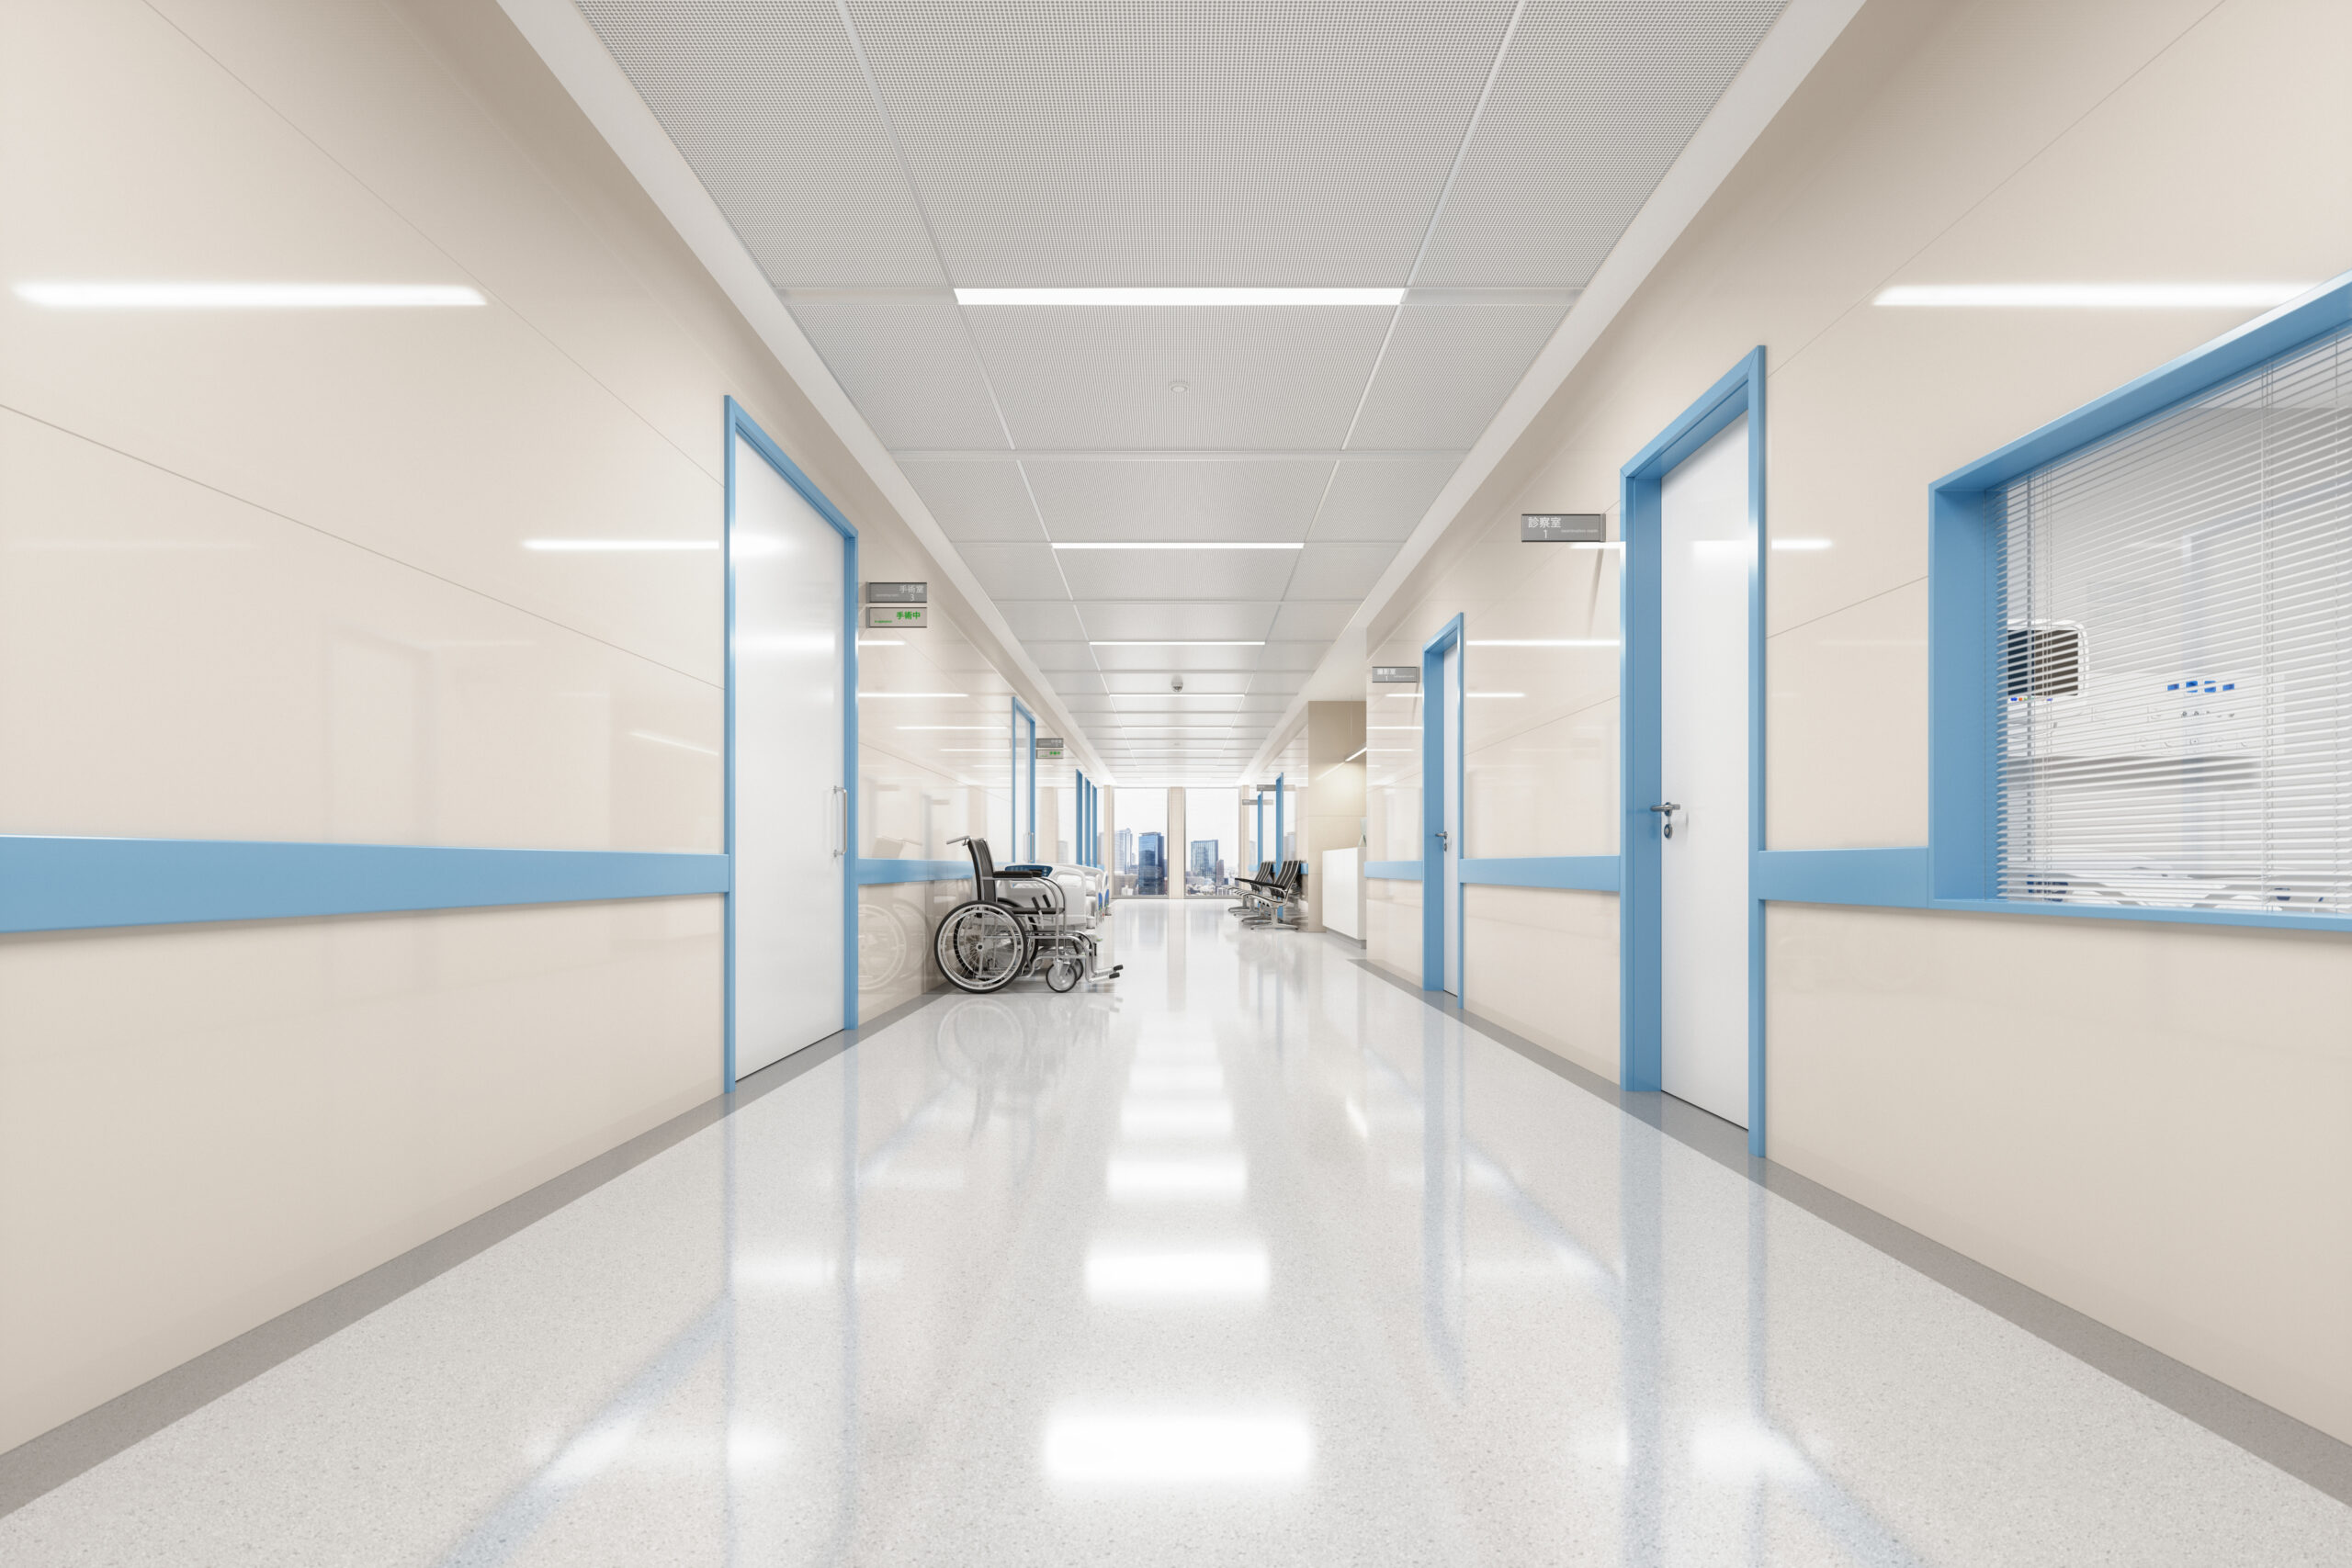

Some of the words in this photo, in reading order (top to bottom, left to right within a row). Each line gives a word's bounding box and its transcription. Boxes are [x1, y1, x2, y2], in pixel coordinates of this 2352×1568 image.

[1528, 516, 1562, 528] 診察室
[1544, 529, 1548, 539] 1
[899, 584, 924, 593] 手術室
[910, 593, 915, 602] 3
[896, 611, 921, 620] 手術中
